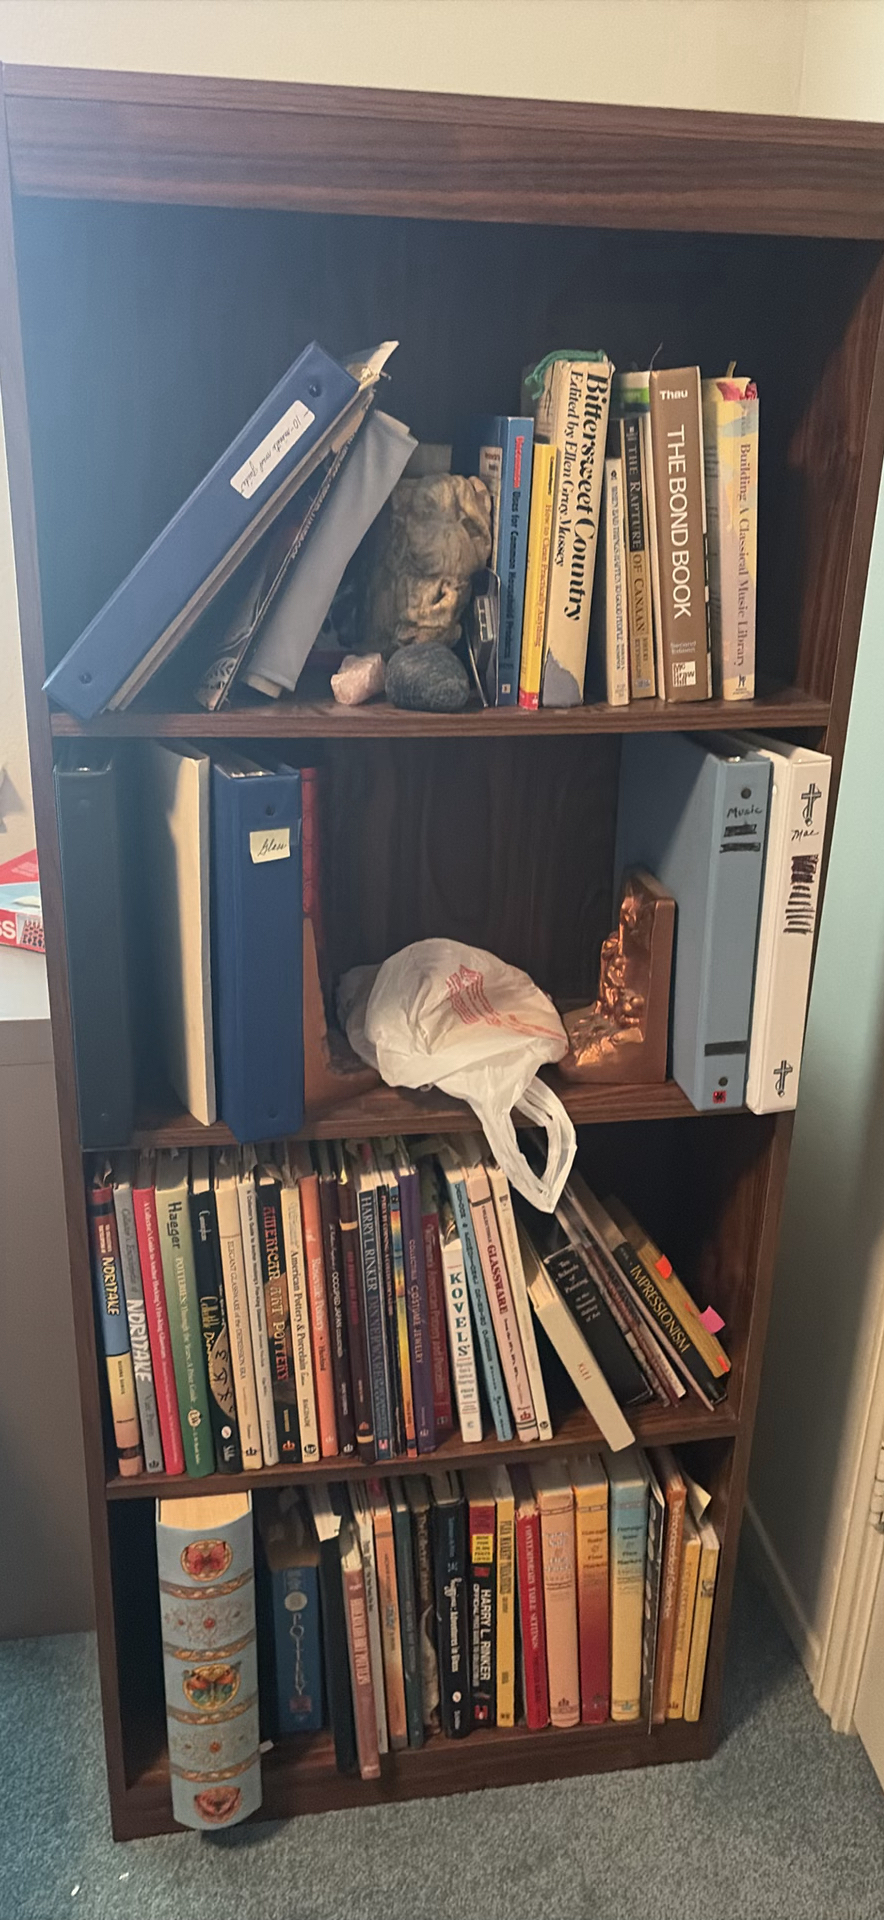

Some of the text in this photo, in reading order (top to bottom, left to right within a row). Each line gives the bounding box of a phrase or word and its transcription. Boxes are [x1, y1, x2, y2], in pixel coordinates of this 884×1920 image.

[567, 371, 583, 418] Edited
[659, 390, 687, 401] Thau
[564, 422, 579, 438] by
[562, 440, 578, 477] Ellen
[628, 447, 637, 475] THE
[736, 444, 752, 502] Building
[512, 491, 521, 512] Uses
[564, 372, 609, 620] Bittersweet Country
[629, 482, 642, 549] RAPTURE
[512, 514, 520, 528] for
[666, 424, 692, 620] THE BOND BOOK
[509, 531, 519, 570] Common
[554, 517, 572, 567] Massey
[738, 518, 750, 576] Classical
[534, 504, 552, 647] How to Clean Practically Anything
[632, 554, 642, 572] OF
[633, 578, 645, 634] CANAAN
[737, 580, 749, 618] Music
[733, 621, 748, 668] Library
[726, 804, 763, 819] Music
[166, 1202, 182, 1249] Haeger
[360, 1196, 375, 1237] HARRY
[148, 1237, 156, 1252] Guide
[227, 1241, 236, 1271] ELEGANT
[102, 1256, 120, 1316] NORITAKE
[290, 1250, 301, 1292] American
[364, 1249, 378, 1292] RINKER
[428, 1270, 438, 1310] American
[486, 1244, 508, 1314] GLASSWARE
[230, 1272, 240, 1311] GLASSWARE
[263, 1206, 288, 1380] AMERICAN ART POTTERY
[292, 1292, 304, 1323] Pottery
[311, 1257, 325, 1332] Roseville Pottery
[332, 1272, 342, 1328] OCCUPIED JAPAN
[408, 1285, 421, 1326] COSTUME
[630, 1264, 691, 1353] IMPRESSIONISM
[180, 1306, 190, 1331] Through
[200, 1296, 220, 1328] Collectible
[429, 1310, 440, 1340] Pottery
[126, 1299, 152, 1382] NORITAKE
[183, 1333, 191, 1341] the
[235, 1329, 245, 1366] DEPRESSION
[297, 1333, 308, 1370] Porcelain
[368, 1295, 384, 1377] DINNERWARE
[412, 1329, 423, 1364] JEWELRY
[432, 1340, 442, 1356] and
[187, 1369, 195, 1384] Price
[434, 1357, 444, 1394] Porcelain
[673, 1501, 681, 1514] The
[498, 1521, 512, 1560] FLEA MARKET
[524, 1525, 534, 1584] CONTEMPORARY
[667, 1514, 680, 1561] Encyclopedia
[472, 1584, 480, 1616] OFFICIAL
[480, 1589, 491, 1626] HARRY
[528, 1588, 536, 1611] TABLE
[664, 1576, 676, 1620] Collectibles
[450, 1612, 460, 1646] Adventures
[530, 1612, 538, 1649] SETTINGS
[452, 1654, 460, 1673] Glass
[480, 1641, 492, 1680] RINKER
